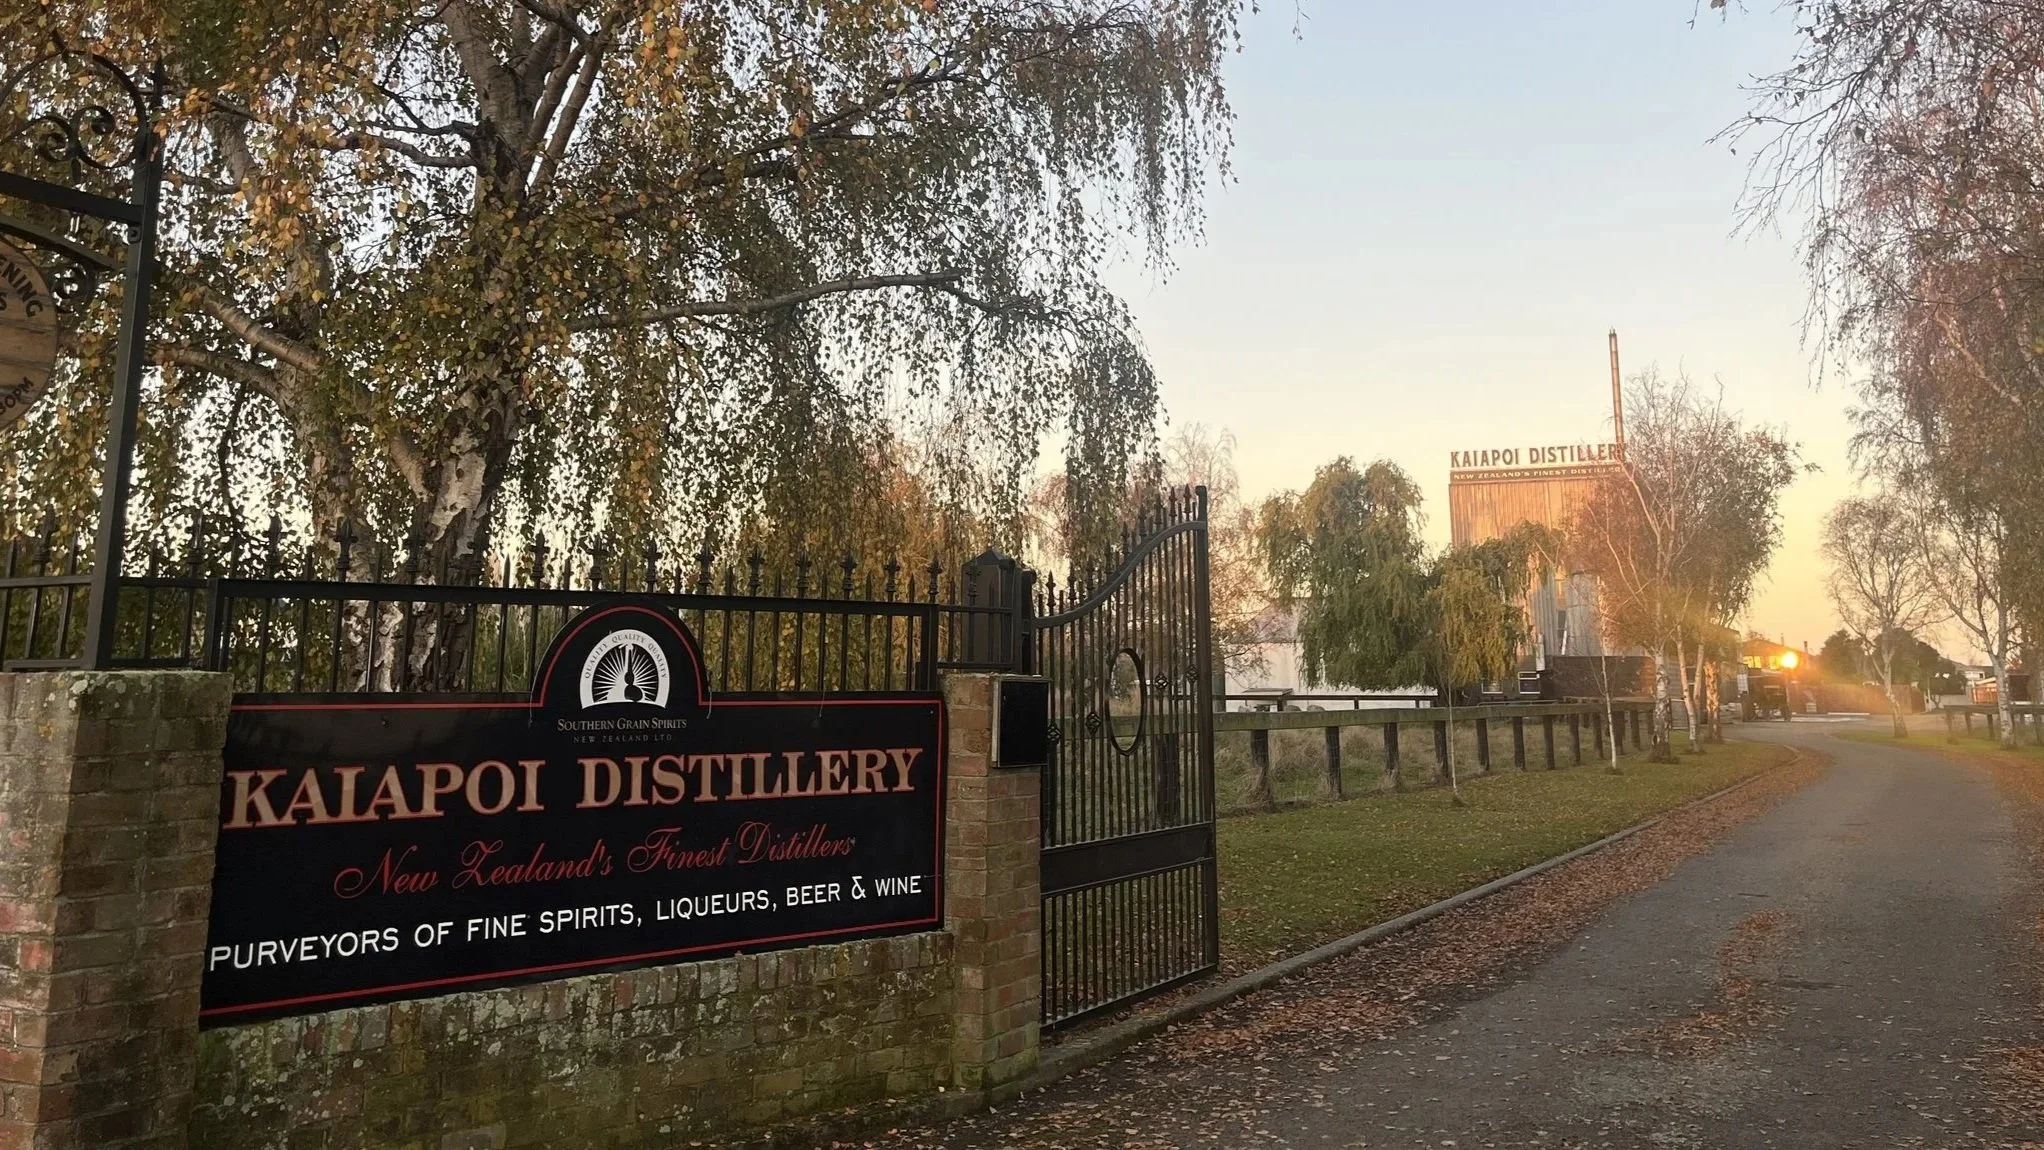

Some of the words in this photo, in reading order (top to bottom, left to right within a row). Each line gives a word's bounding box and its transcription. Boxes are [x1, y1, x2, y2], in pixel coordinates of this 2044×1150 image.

[1450, 448, 1519, 468] KAIAPOI
[1478, 470, 1530, 479] ZEALAND'S
[1533, 468, 1567, 476] FINEST
[584, 643, 608, 679] QUALITY
[611, 633, 645, 644] QUALITY
[647, 643, 667, 678] QUALITY
[573, 735, 596, 744] NEW
[601, 734, 649, 743] ZEALAND
[654, 733, 673, 741] LTD
[222, 759, 546, 830] KAIAPOI
[575, 747, 923, 810] DISTILLERY
[333, 844, 440, 899] New
[451, 839, 612, 890] Zealand's
[626, 827, 732, 873] Finest
[734, 821, 852, 864] Distillers
[209, 927, 399, 971] PURVEYORS
[413, 921, 454, 948] OF
[466, 914, 527, 942] FINE
[539, 903, 642, 934] SPIRITS,
[656, 889, 777, 921] LIQUEURS,
[786, 882, 841, 907] BEER
[850, 875, 867, 900] &
[874, 875, 922, 898] WINE
